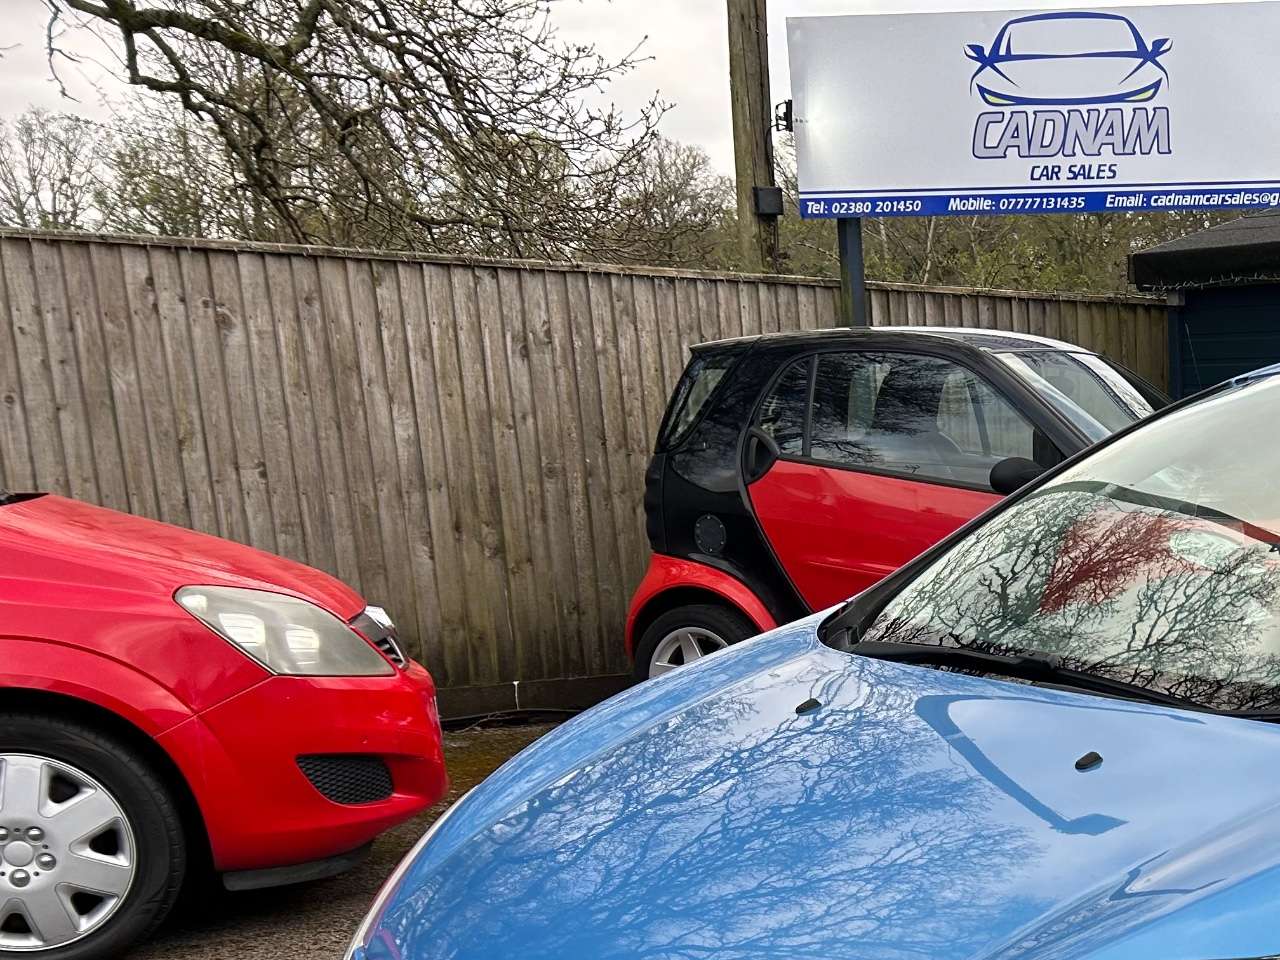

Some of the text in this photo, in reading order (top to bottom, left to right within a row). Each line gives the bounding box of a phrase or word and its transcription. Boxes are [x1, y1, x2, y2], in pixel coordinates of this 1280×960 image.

[972, 107, 1171, 158] CADNAM
[1030, 163, 1117, 181] CAR SALES
[806, 201, 828, 214] Tel:
[832, 202, 872, 213] 02380
[875, 200, 922, 212] 201450
[948, 197, 996, 211] Mobile:
[999, 197, 1085, 210] 07777131435
[1105, 193, 1147, 208] Email:
